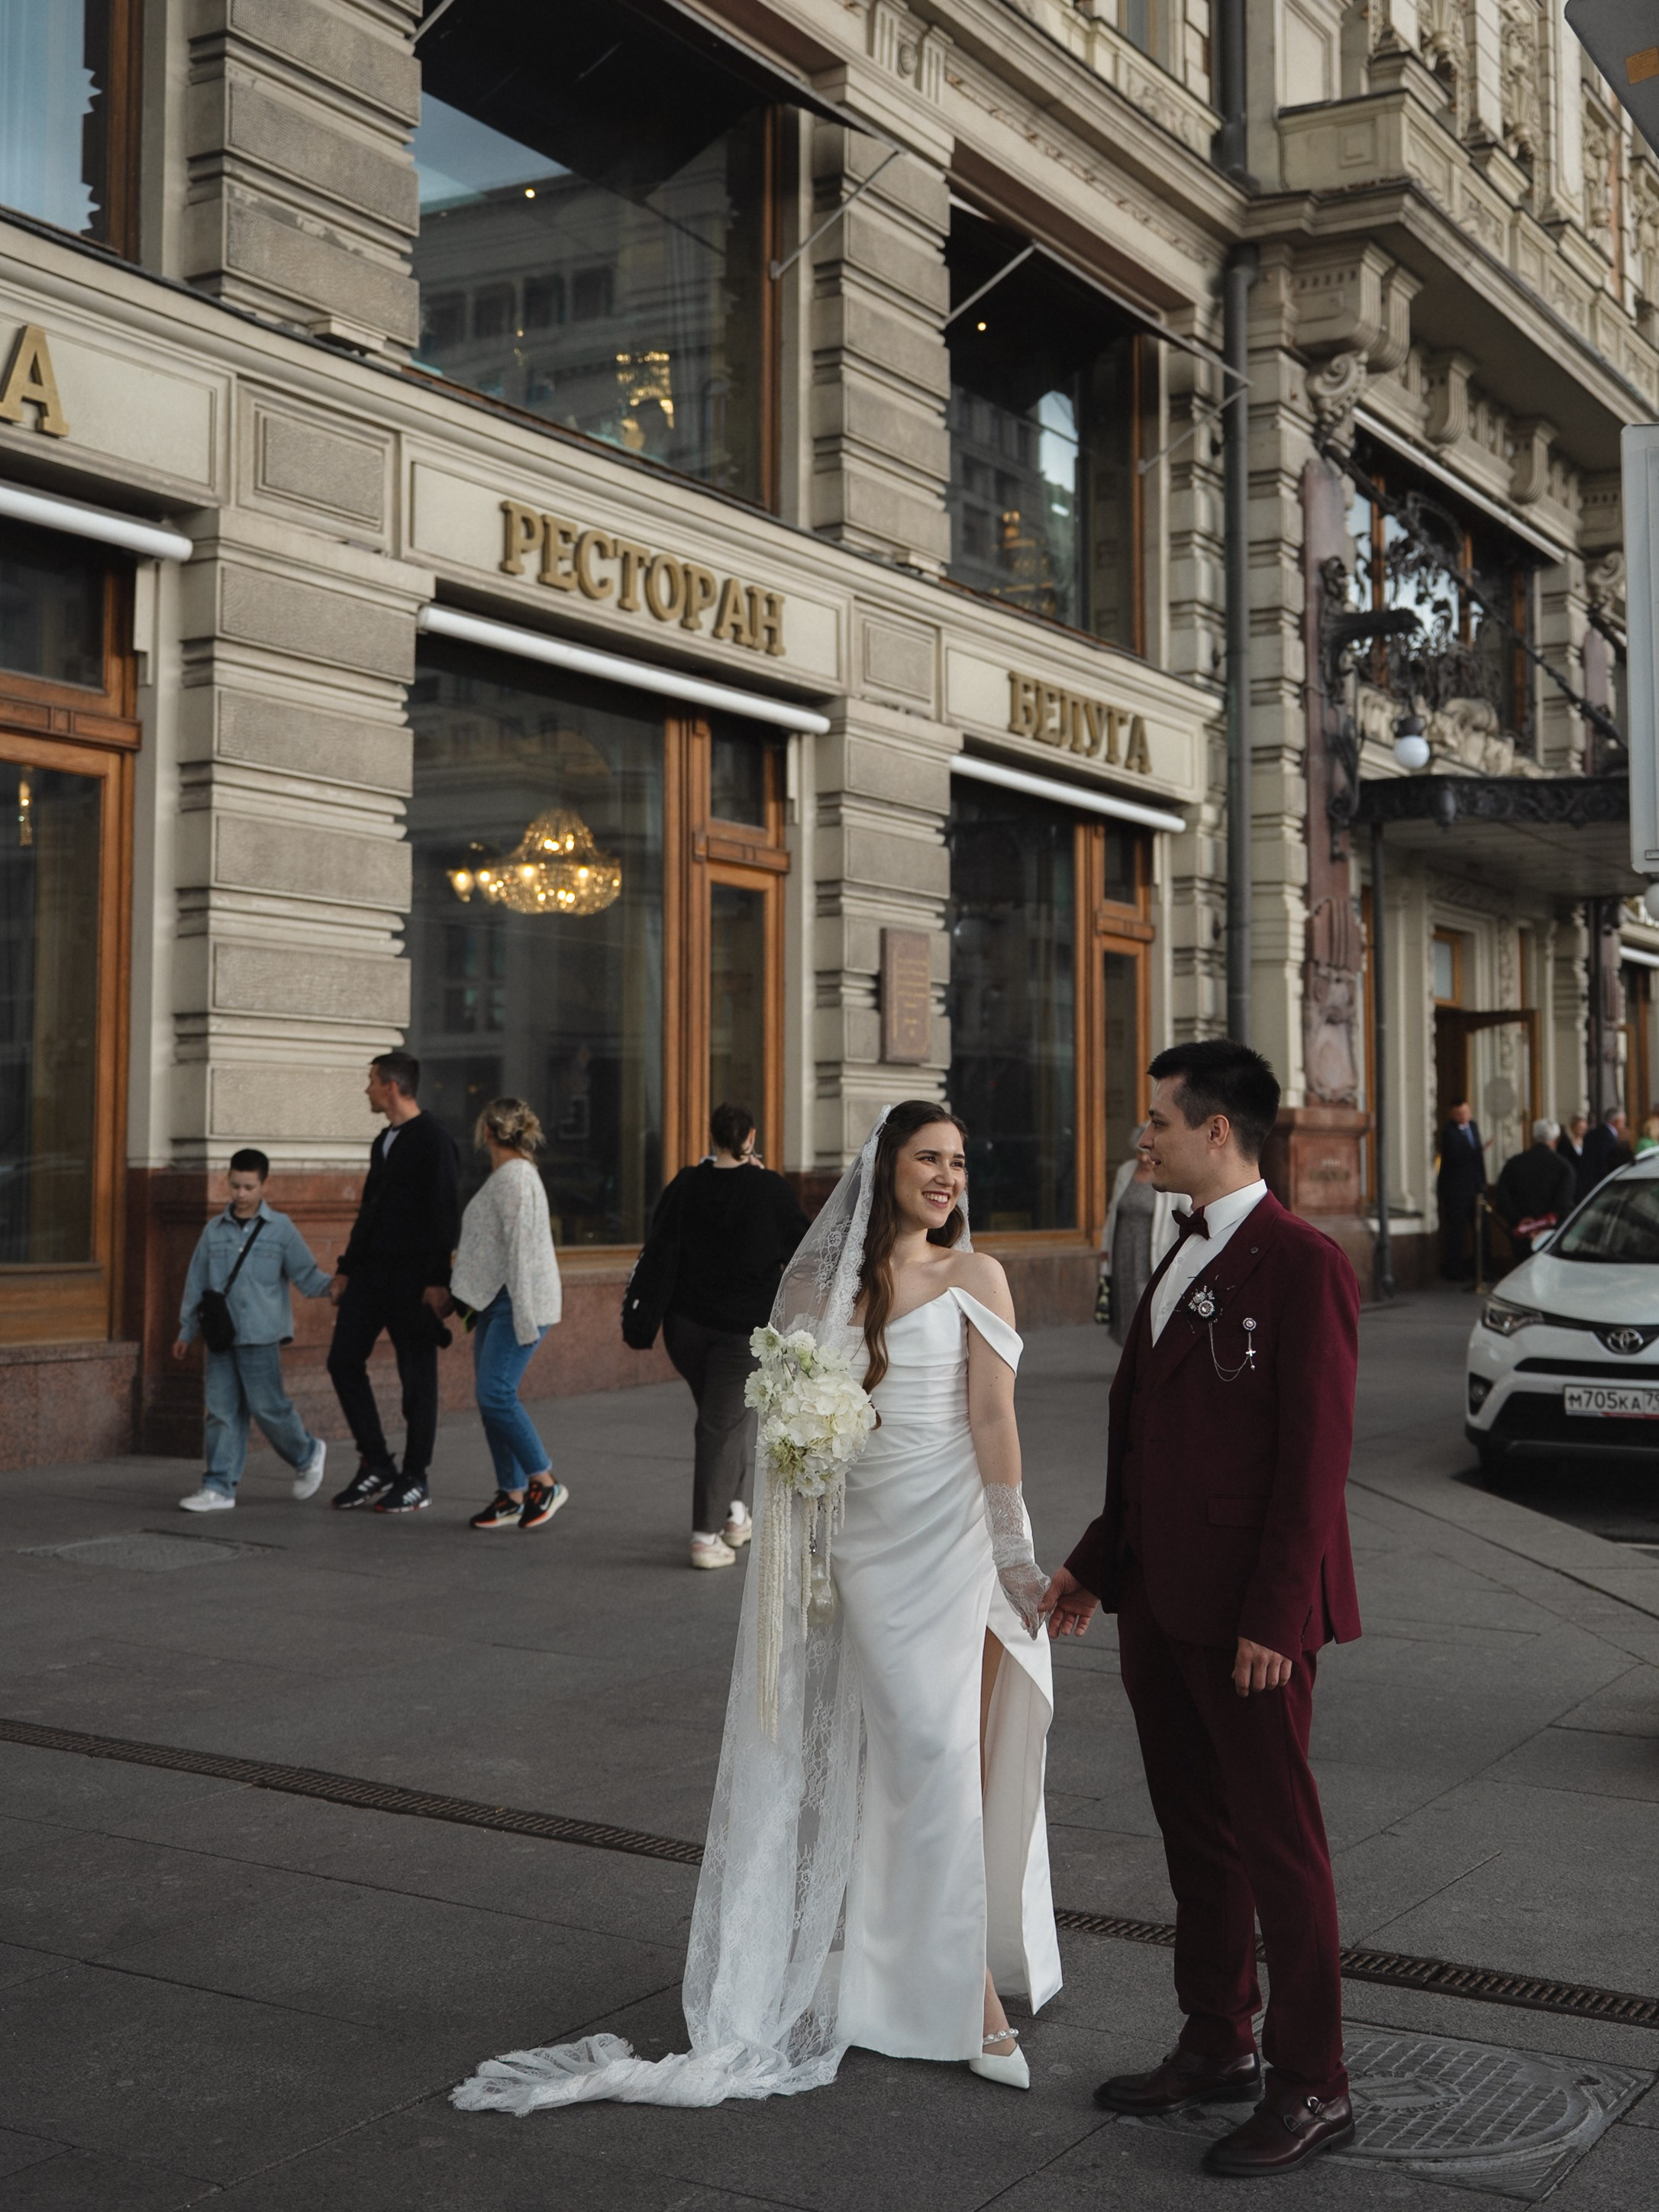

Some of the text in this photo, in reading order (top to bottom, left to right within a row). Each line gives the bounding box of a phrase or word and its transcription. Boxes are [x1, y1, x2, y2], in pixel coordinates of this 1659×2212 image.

[499, 500, 786, 656] РЕСТОРАН
[1008, 670, 1153, 774] БЕЛУГА
[1567, 1390, 1641, 1410] М705КА
